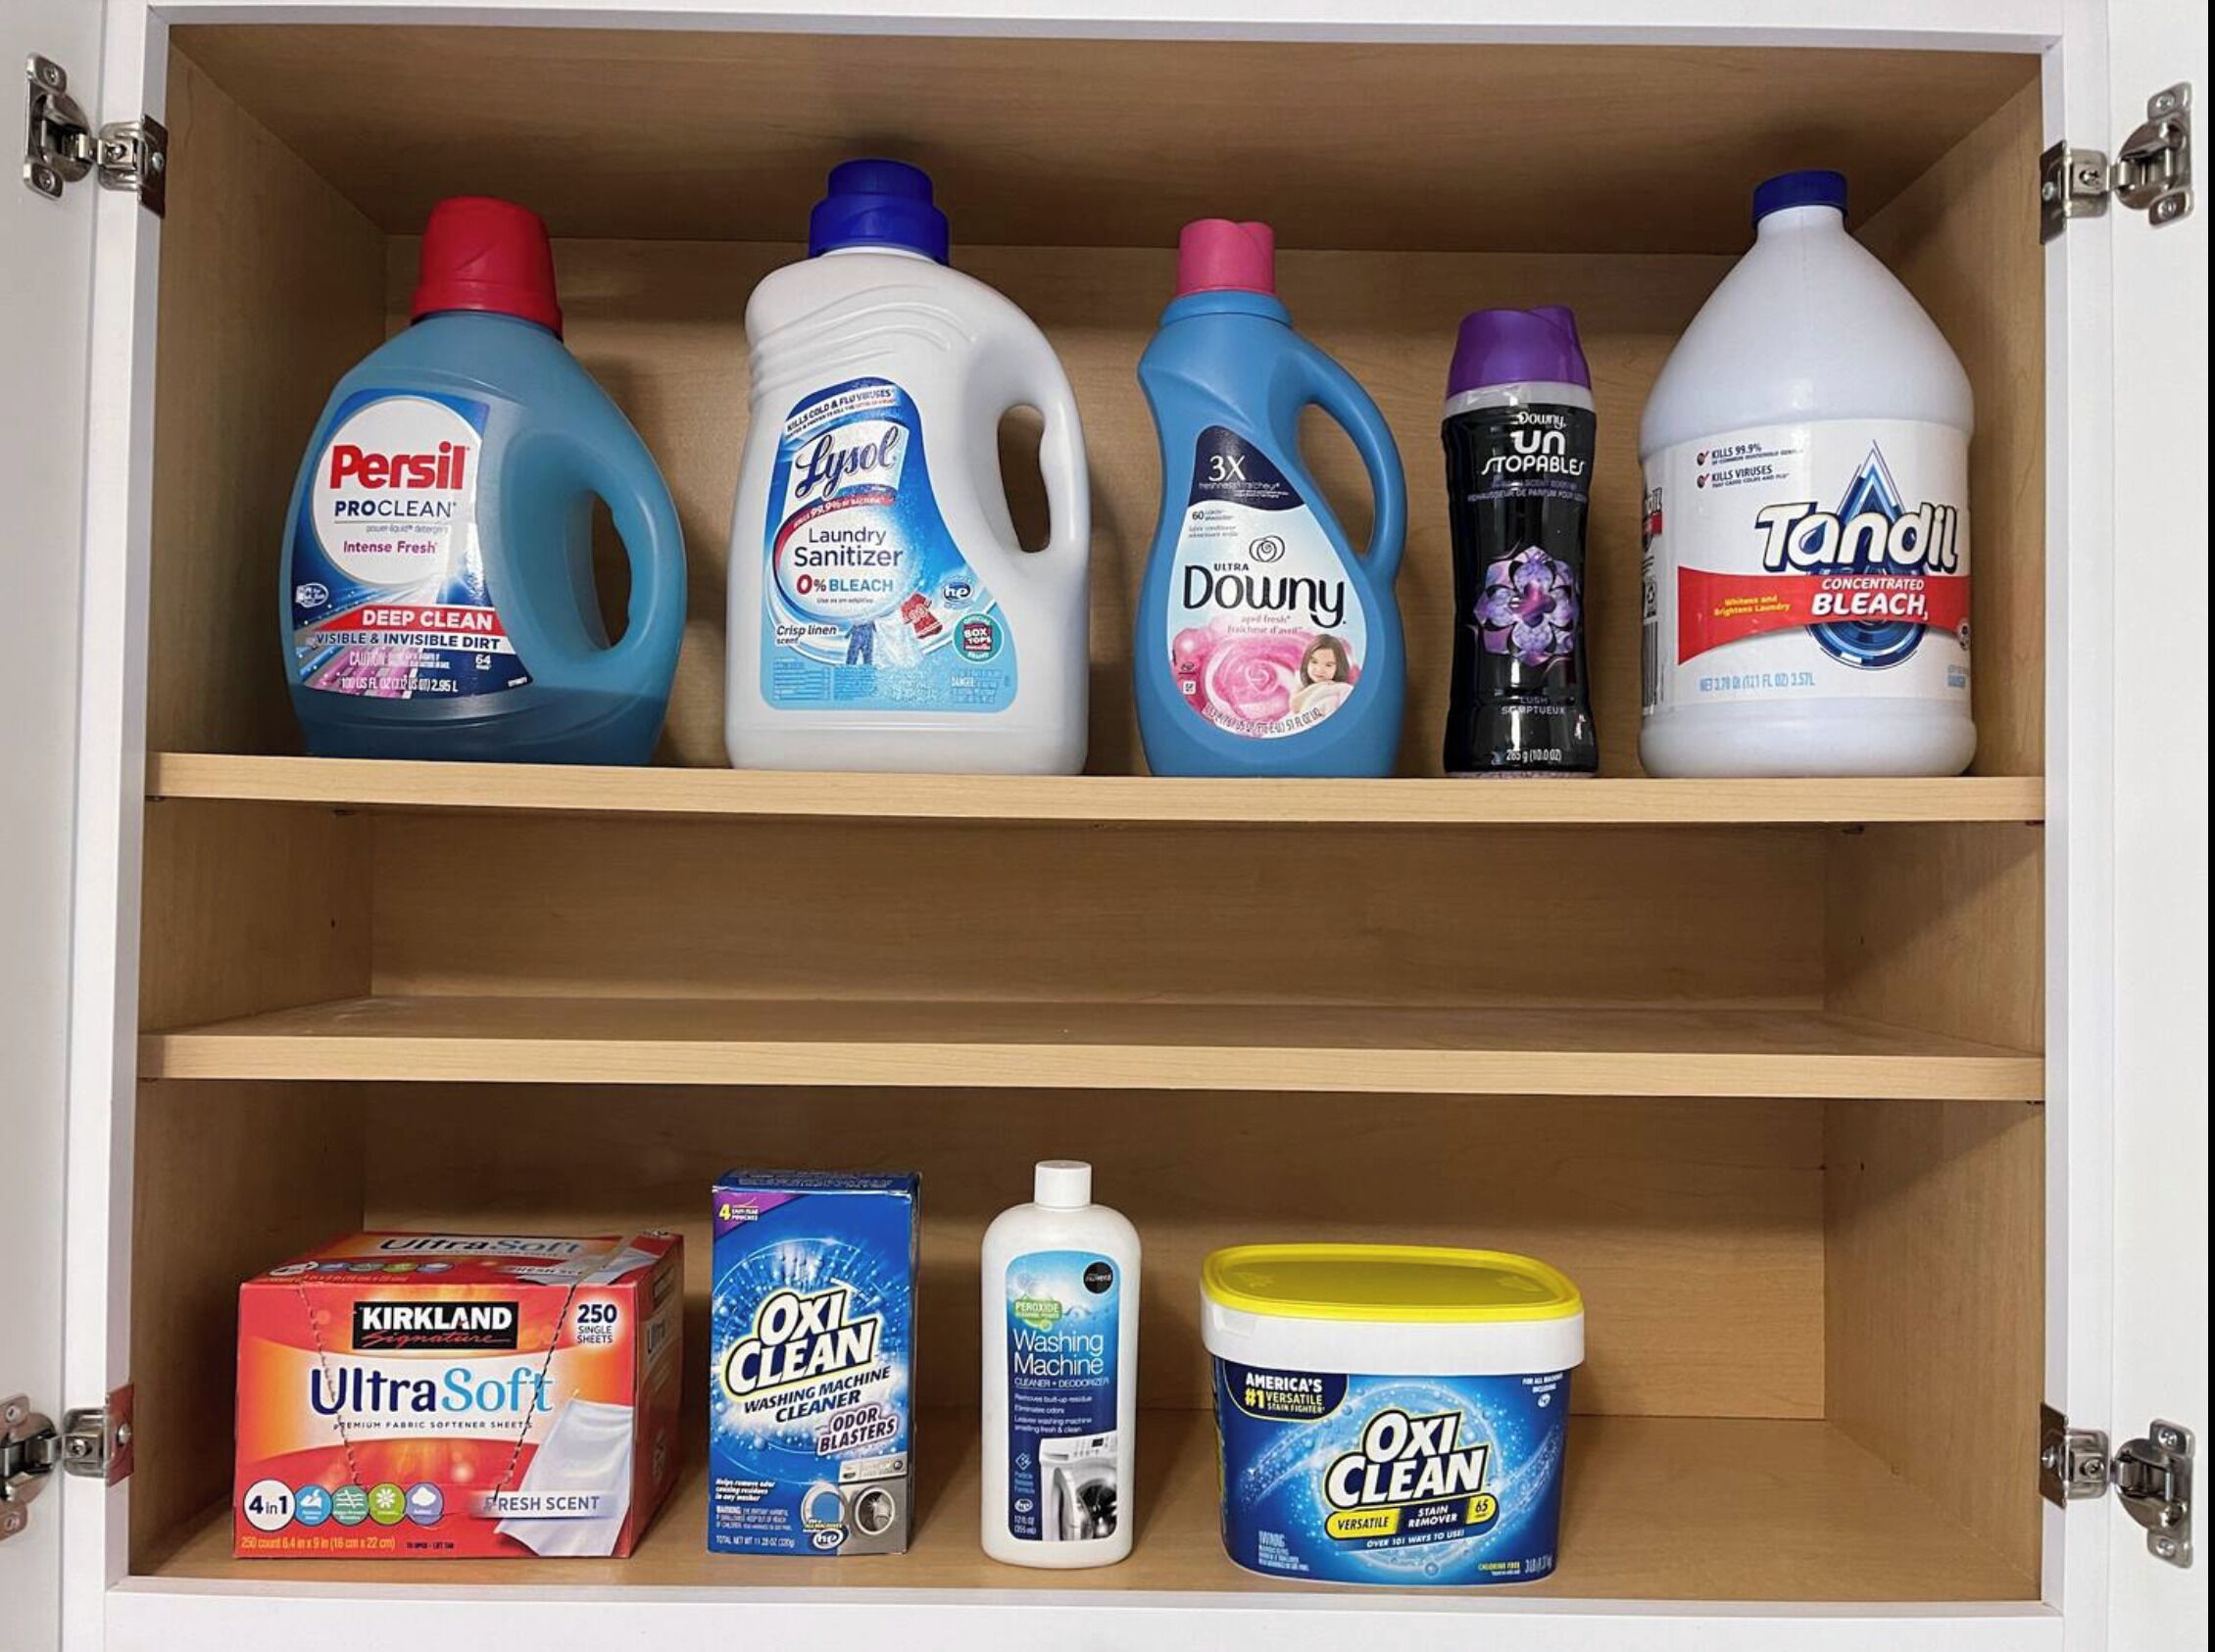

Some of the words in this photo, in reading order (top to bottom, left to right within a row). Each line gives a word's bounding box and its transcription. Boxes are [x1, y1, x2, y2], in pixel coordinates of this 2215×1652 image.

[786, 413, 810, 432] KILLS
[809, 402, 830, 418] COLD
[839, 393, 857, 407] FLU
[1518, 411, 1566, 430] Downy
[1711, 447, 1734, 460] KILLS
[1735, 443, 1762, 456] 99.9%
[329, 441, 467, 491] Persil
[793, 424, 900, 500] Lysol
[1208, 454, 1247, 482] 3X
[1481, 456, 1585, 476] STOPABLES
[1711, 469, 1734, 482] KILLS
[1735, 463, 1773, 478] VIRUSES
[334, 499, 452, 518] PROCLEAN
[1192, 510, 1205, 521] 60
[809, 527, 887, 546] Laundry
[1754, 500, 1959, 574] Tandil
[343, 540, 393, 554] Intense
[397, 540, 437, 555] Fresh
[794, 545, 904, 567] Sanitizer
[796, 573, 827, 595] 0%
[828, 578, 894, 593] BLEACH
[1821, 577, 1925, 591] CONCENTRATED
[1182, 564, 1347, 629] Downy
[1811, 592, 1926, 616] BLEACH
[362, 609, 416, 626] DEEP
[419, 612, 493, 631] CLEAN
[776, 625, 807, 638] Crisp
[807, 624, 837, 636] linen
[962, 627, 987, 639] BOX
[316, 632, 367, 645] VISIBLE
[369, 636, 379, 645] &
[383, 633, 460, 648] INVISIBLE
[462, 637, 501, 650] DIRT
[475, 655, 491, 665] 64
[452, 680, 459, 693] L
[1523, 752, 1529, 763] g
[718, 1203, 732, 1221] 4
[576, 1303, 617, 1324] 250
[1015, 1301, 1059, 1314] PEROXIDE
[361, 1306, 513, 1331] KIRKLAND
[758, 1288, 848, 1348] OXI
[361, 1330, 512, 1348] Signature
[576, 1335, 614, 1344] SHEETS
[577, 1325, 613, 1335] SINGLE
[1013, 1328, 1104, 1354] Washing
[728, 1319, 877, 1394] CLEAN
[1014, 1352, 1104, 1376] Machine
[310, 1367, 554, 1416] UltraSoft
[744, 1386, 815, 1414] WASHING
[817, 1365, 892, 1396] MACHINE
[1013, 1377, 1051, 1387] CLEANER
[1058, 1377, 1109, 1388] DEODORIZER
[1246, 1372, 1323, 1393] AMERICA'S
[775, 1389, 861, 1423] CLEANER
[1014, 1392, 1043, 1403] Removes
[1245, 1387, 1265, 1410] #1
[1265, 1390, 1323, 1405] VERSATILE
[1266, 1401, 1290, 1412] STAIN
[1014, 1404, 1045, 1414] Eliminates
[832, 1407, 878, 1433] ODOR
[1014, 1415, 1037, 1424] Leaves
[1037, 1417, 1064, 1427] washing
[1014, 1425, 1040, 1433] smelling
[1040, 1426, 1057, 1434] fresh
[819, 1418, 896, 1453] BLASTERS
[1363, 1410, 1461, 1463] OXI
[715, 1479, 733, 1488] Helps
[1324, 1446, 1488, 1509] CLEAN
[248, 1494, 265, 1515] 4
[266, 1501, 277, 1515] in
[278, 1495, 288, 1515] 1
[484, 1496, 541, 1511] FRESH
[545, 1496, 601, 1511] SCENT
[1418, 1505, 1449, 1518] STAIN
[1474, 1499, 1489, 1513] 65
[1337, 1517, 1389, 1531] VERSATILE
[1407, 1513, 1458, 1529] REMOVER
[241, 1537, 258, 1549] 250
[258, 1537, 282, 1549] count
[282, 1536, 296, 1549] 6.4
[314, 1537, 320, 1549] 9
[330, 1536, 343, 1550] (16
[344, 1539, 359, 1549] cm
[367, 1537, 378, 1549] 22
[379, 1536, 396, 1550] cm)
[1366, 1539, 1389, 1548] OVER
[1392, 1537, 1405, 1546] 101
[1407, 1534, 1432, 1544] WAYS
[1434, 1532, 1445, 1541] TO
[1446, 1530, 1465, 1540] USE!
